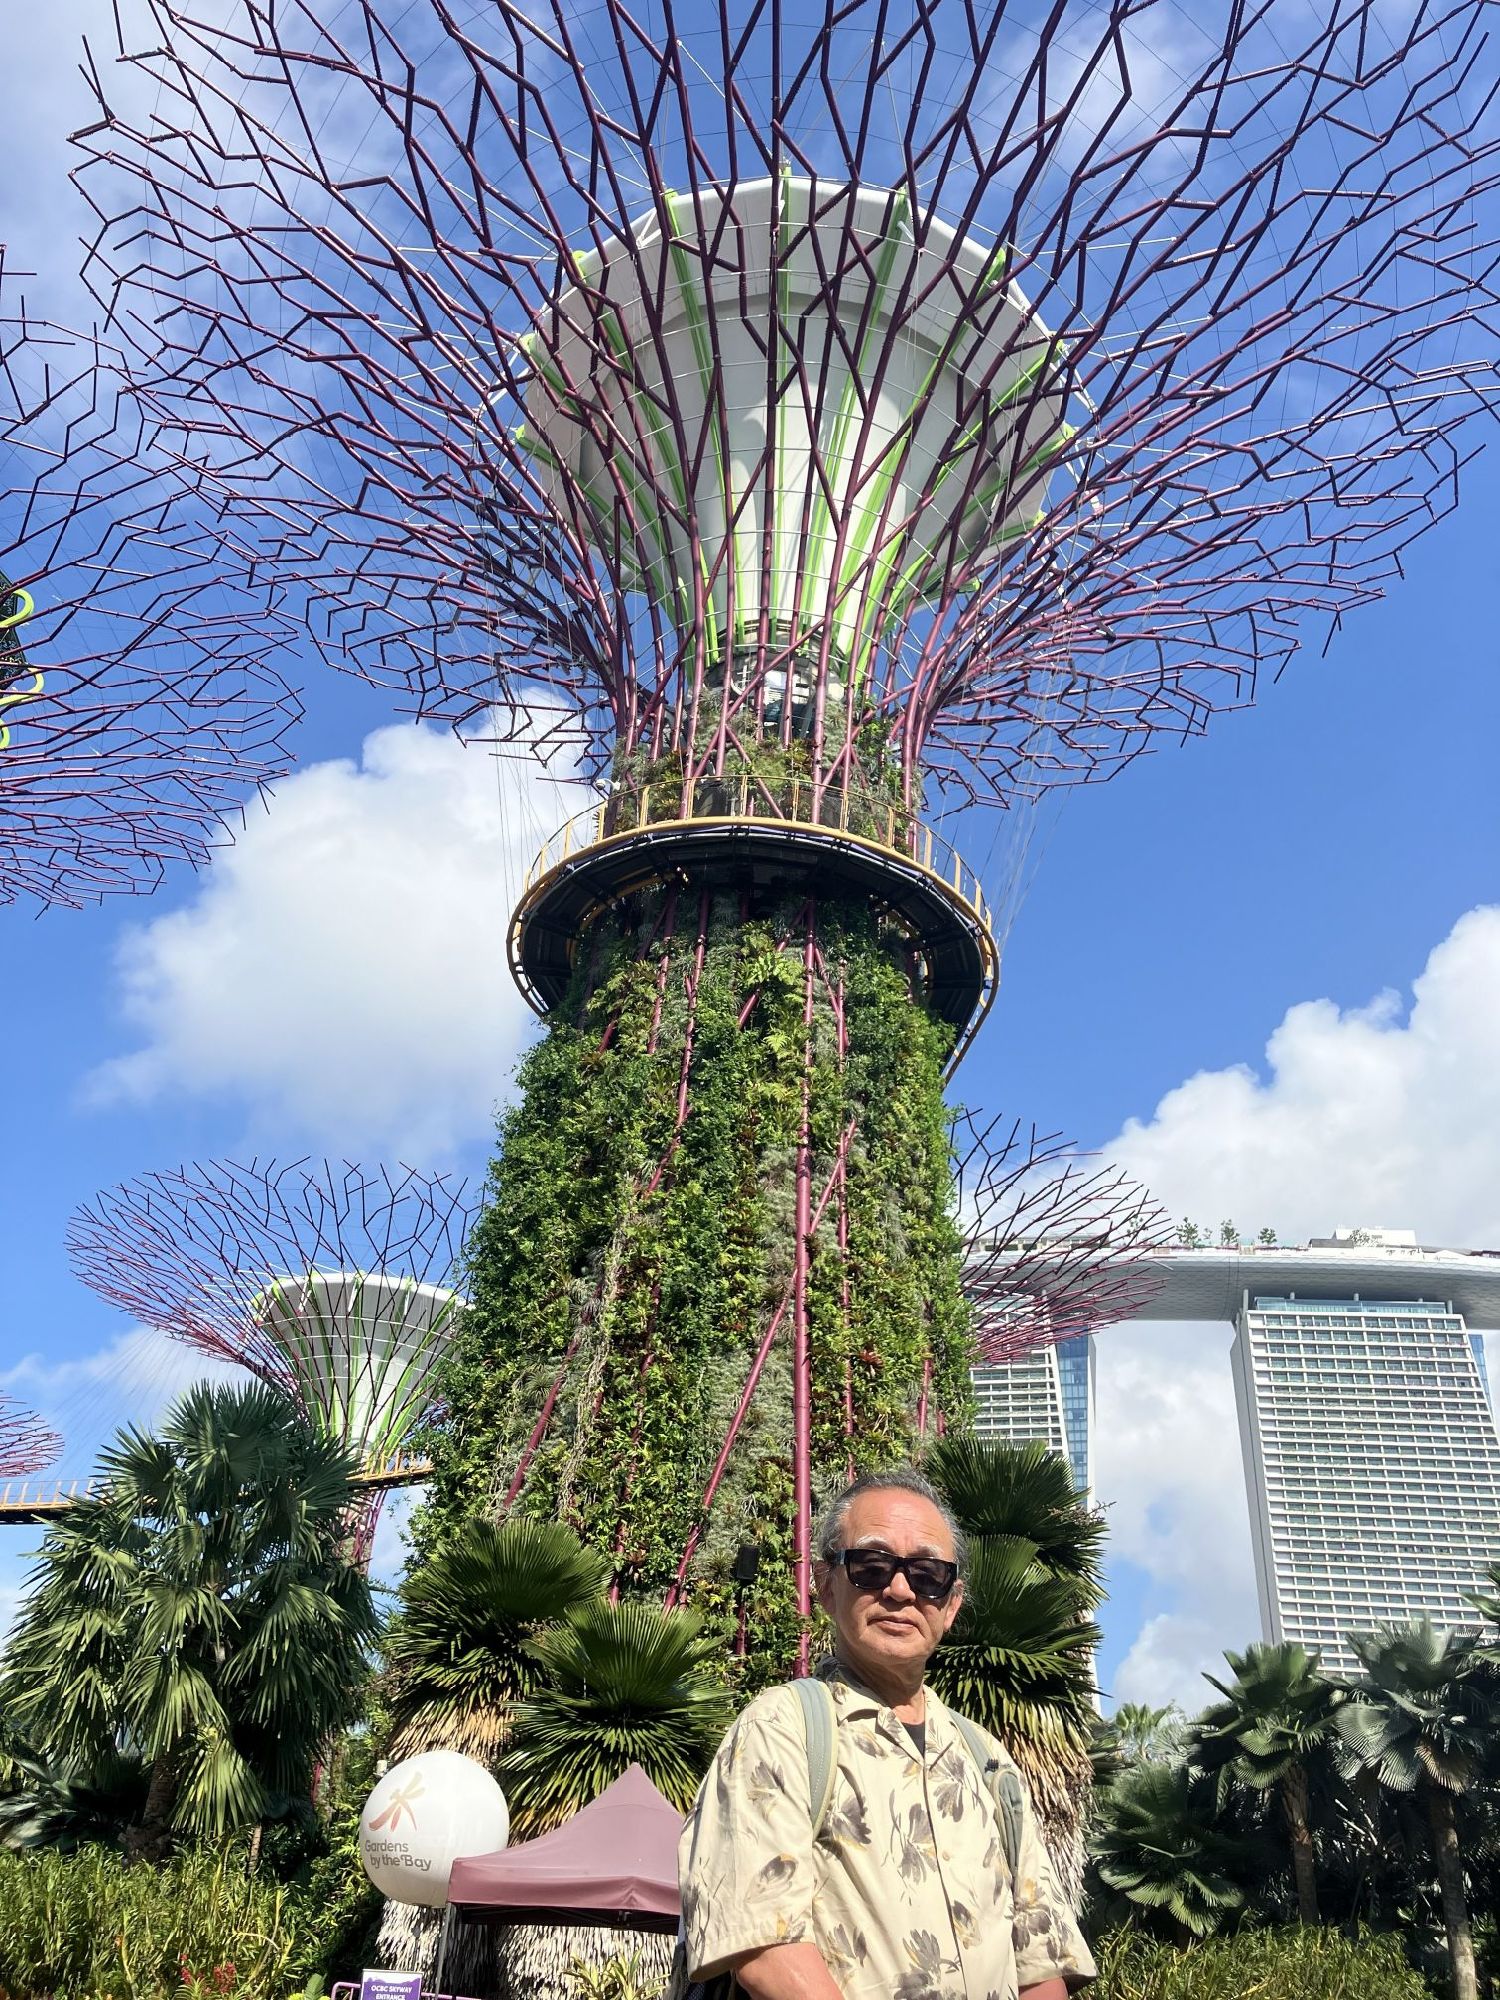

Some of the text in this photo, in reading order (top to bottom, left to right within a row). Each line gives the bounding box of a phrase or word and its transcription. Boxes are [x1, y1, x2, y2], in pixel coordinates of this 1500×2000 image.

[365, 1839, 409, 1853] Gardens
[370, 1854, 432, 1871] by the Bay
